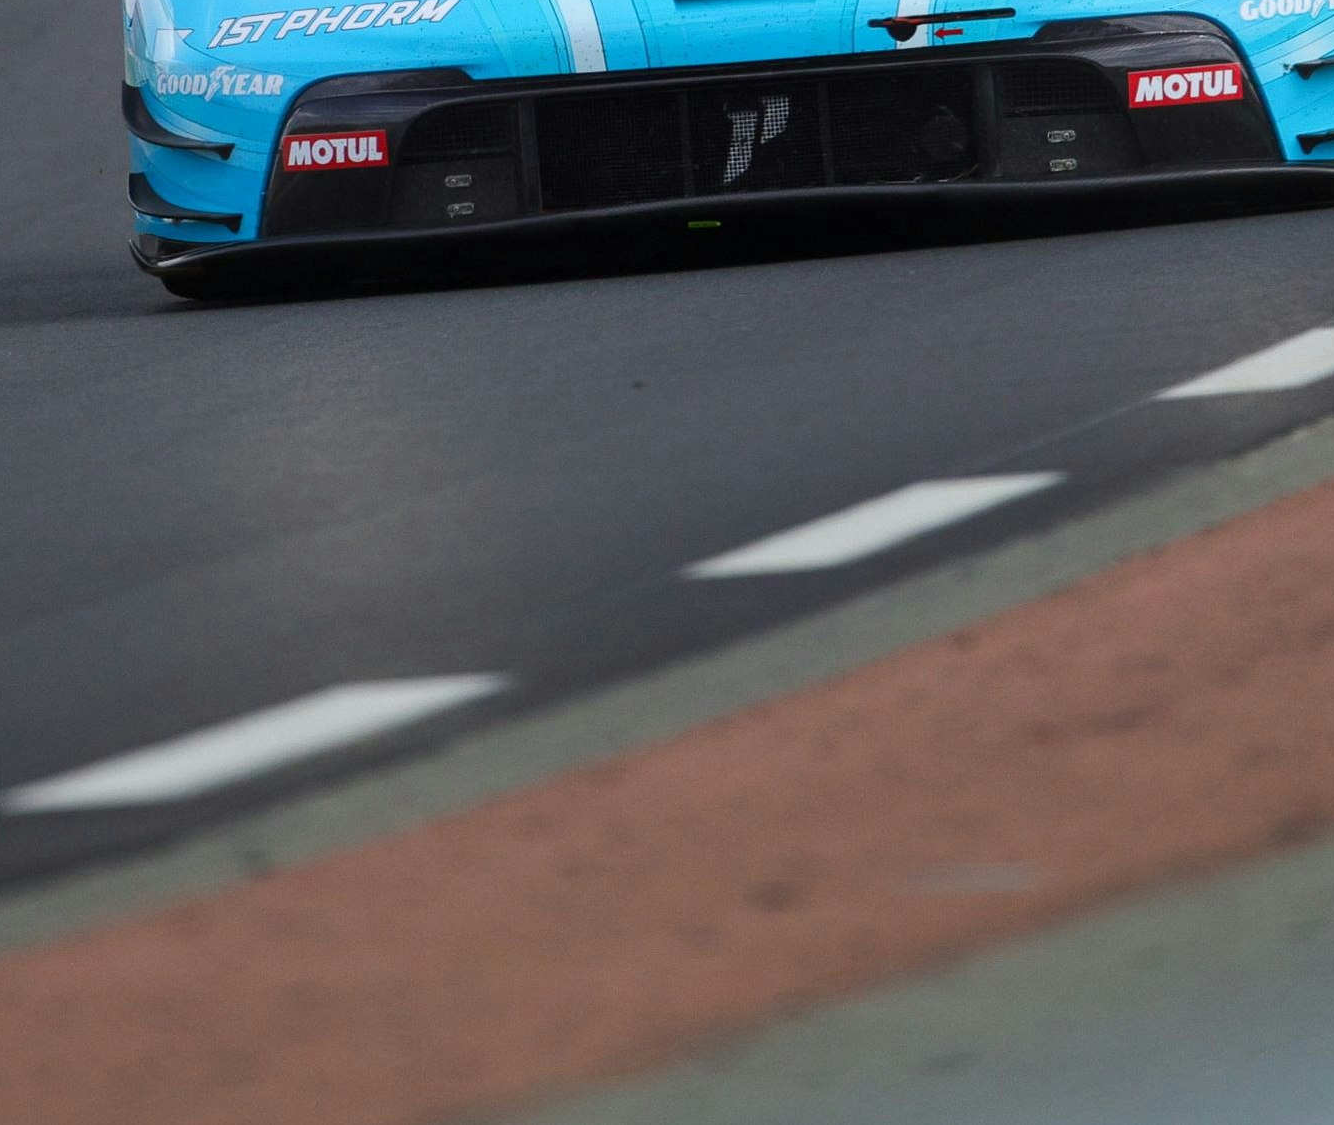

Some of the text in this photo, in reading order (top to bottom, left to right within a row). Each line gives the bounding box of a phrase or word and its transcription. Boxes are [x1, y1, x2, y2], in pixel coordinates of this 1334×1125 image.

[207, 11, 286, 49] 1ST
[1135, 69, 1238, 103] MOTUL
[287, 136, 382, 166] MOTUL
